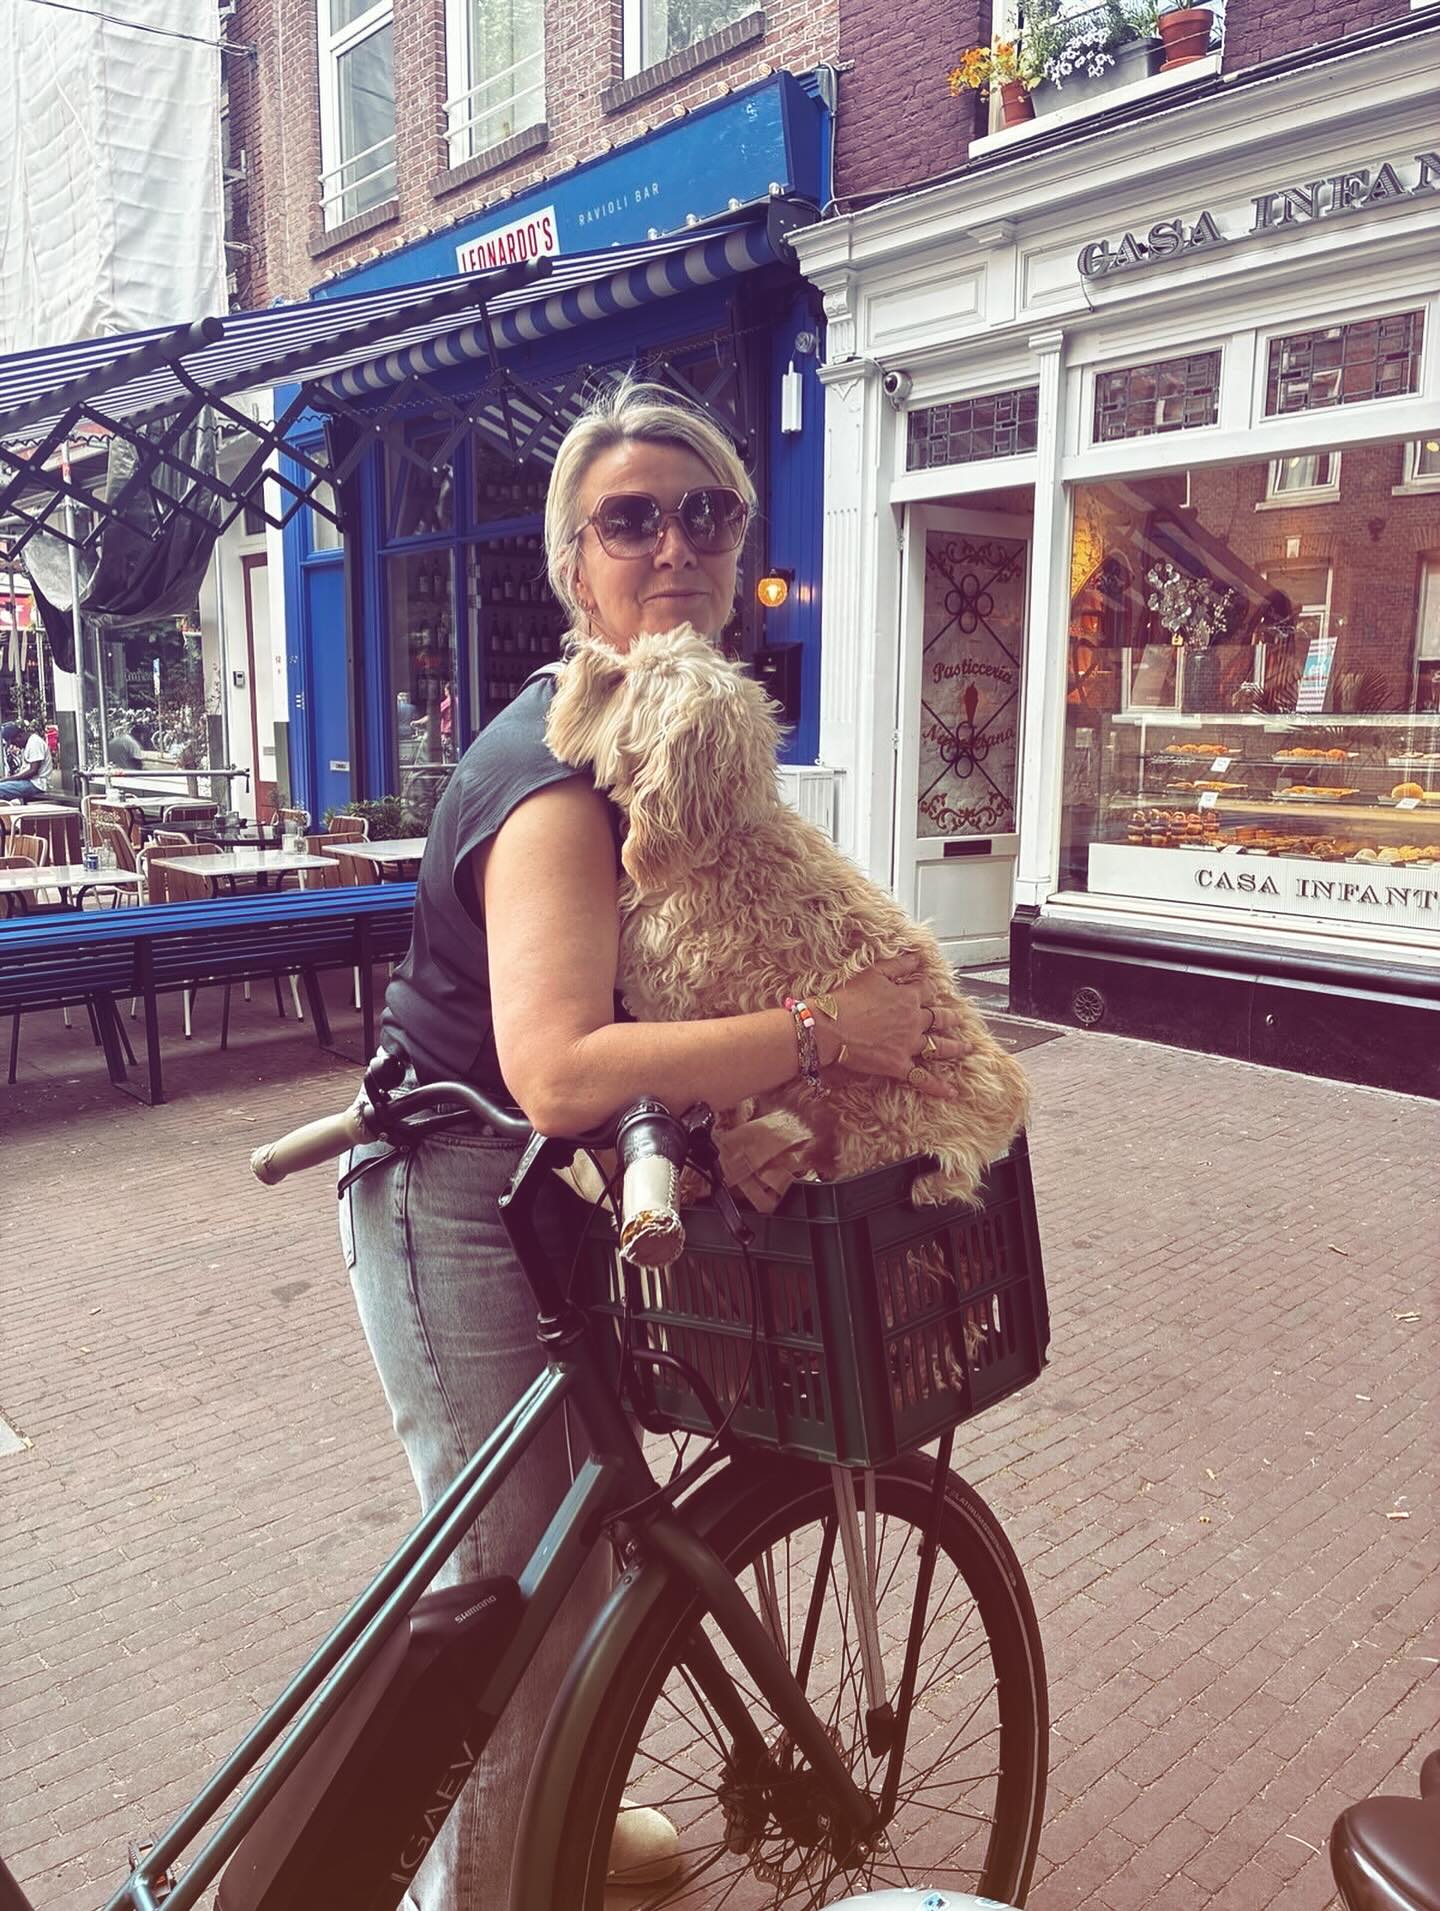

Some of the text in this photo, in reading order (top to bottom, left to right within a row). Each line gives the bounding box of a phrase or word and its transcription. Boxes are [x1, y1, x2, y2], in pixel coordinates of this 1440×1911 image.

[578, 182, 660, 226] RAVIOLI BAR
[1078, 210, 1227, 277] CASA
[932, 658, 1013, 685] Pasticceria
[1195, 868, 1280, 895] CASA
[454, 1594, 497, 1624] SHIMANO
